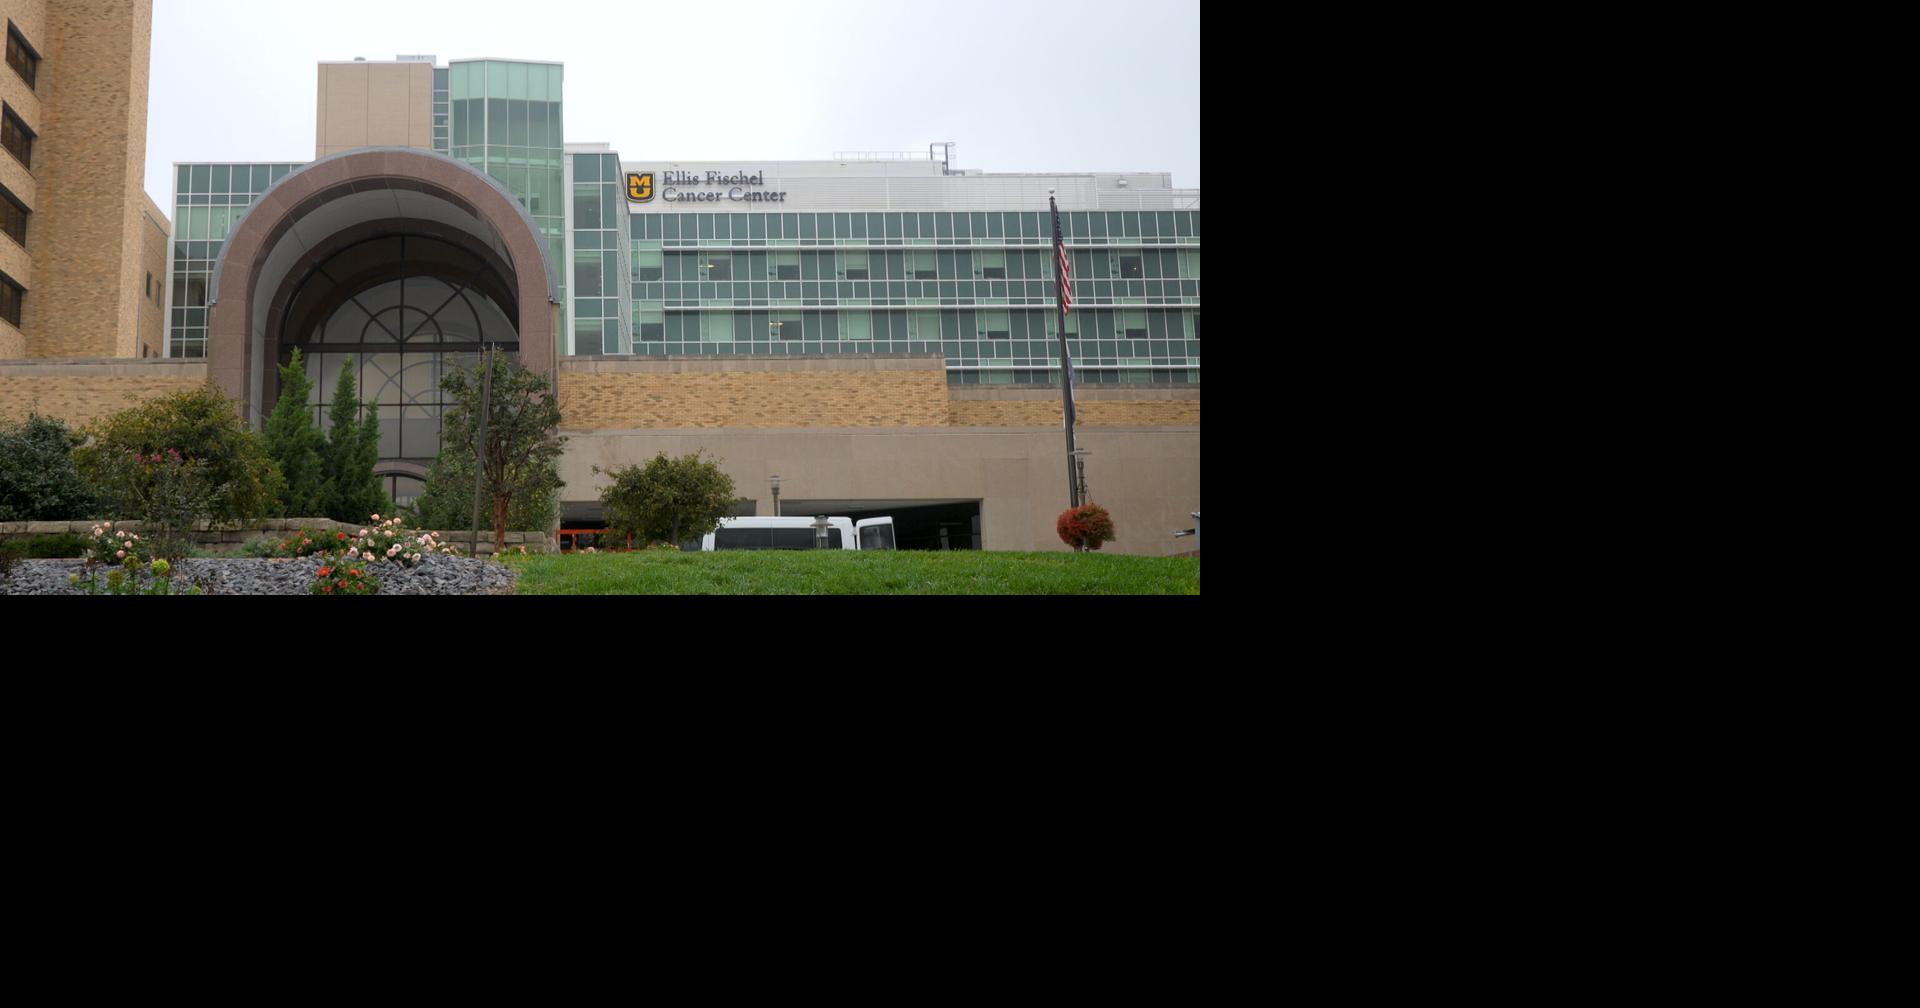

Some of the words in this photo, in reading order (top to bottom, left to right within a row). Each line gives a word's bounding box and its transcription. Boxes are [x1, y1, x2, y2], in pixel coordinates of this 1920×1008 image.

[662, 170, 699, 185] Ellis
[705, 170, 764, 185] Fischel
[662, 187, 723, 202] Cancer
[728, 187, 787, 202] Center
